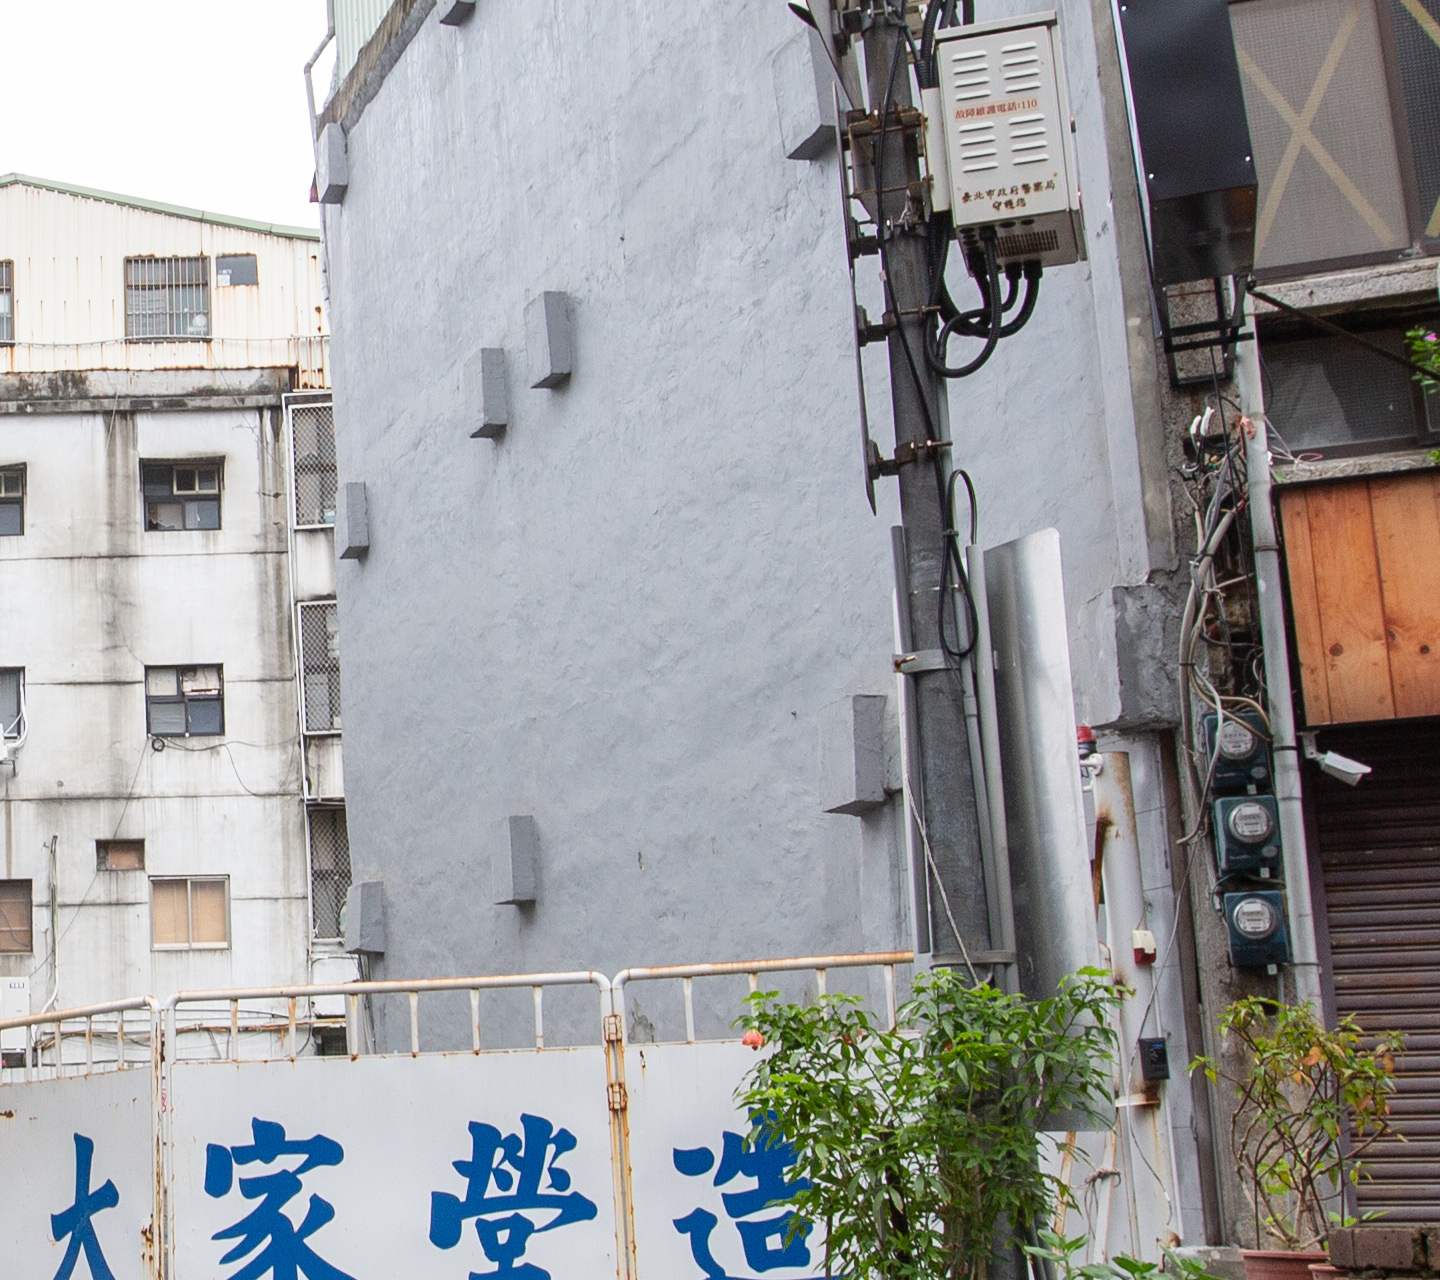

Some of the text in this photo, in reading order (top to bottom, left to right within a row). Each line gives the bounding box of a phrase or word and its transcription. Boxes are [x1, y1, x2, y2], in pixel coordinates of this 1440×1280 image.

[962, 179, 1055, 204] 臺北市政府警察局
